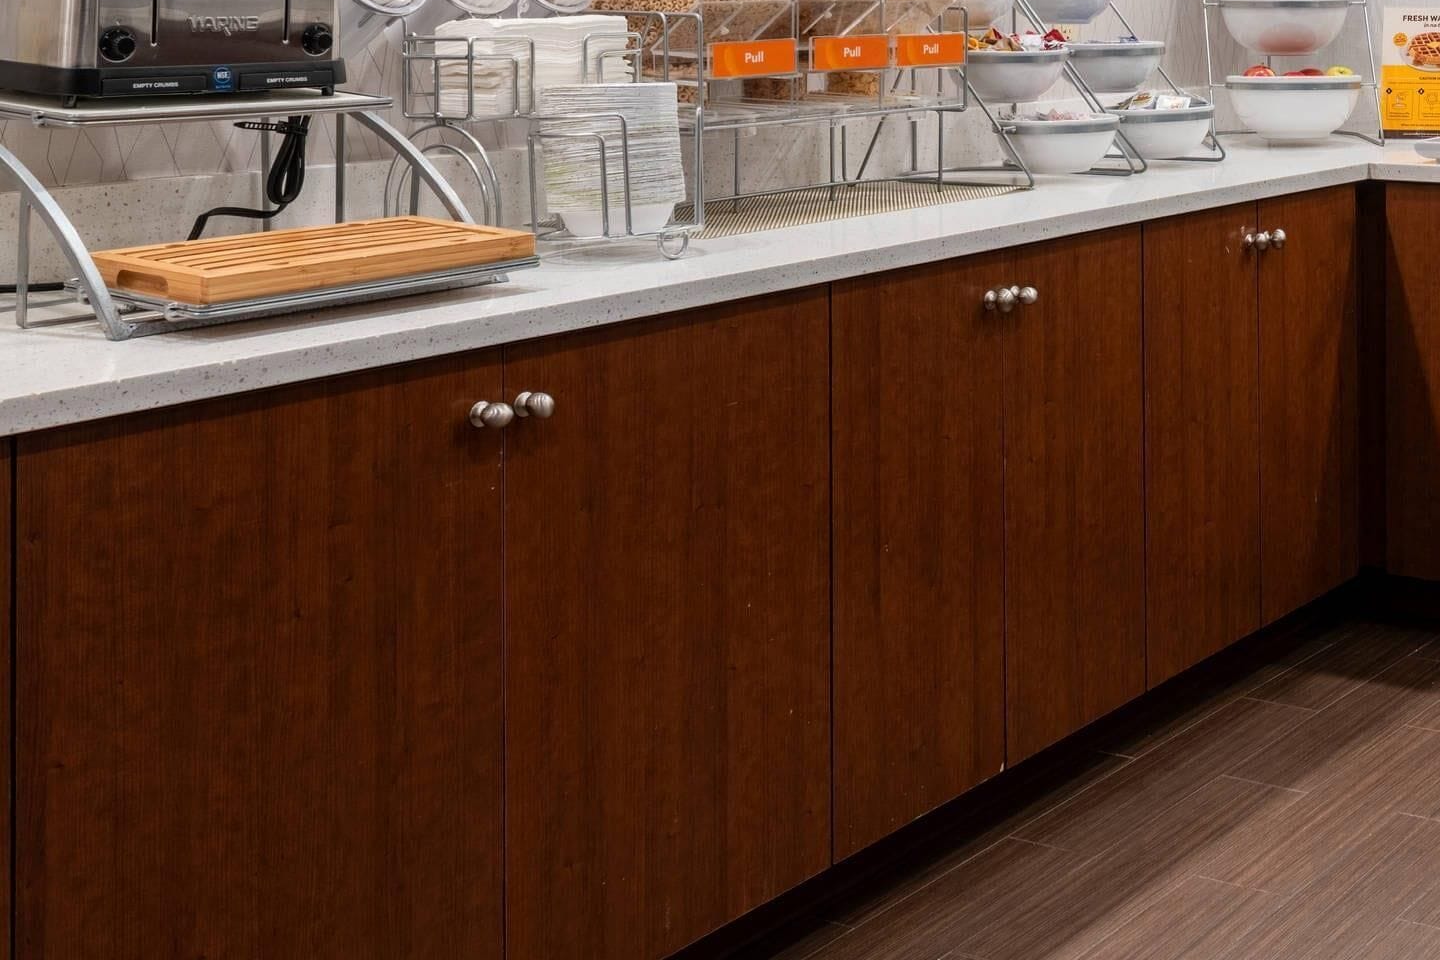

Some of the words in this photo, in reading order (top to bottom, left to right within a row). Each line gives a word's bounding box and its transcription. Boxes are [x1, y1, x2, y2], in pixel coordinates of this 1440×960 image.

[843, 46, 861, 58] Pull
[923, 43, 939, 55] Pull
[744, 51, 764, 64] Pull
